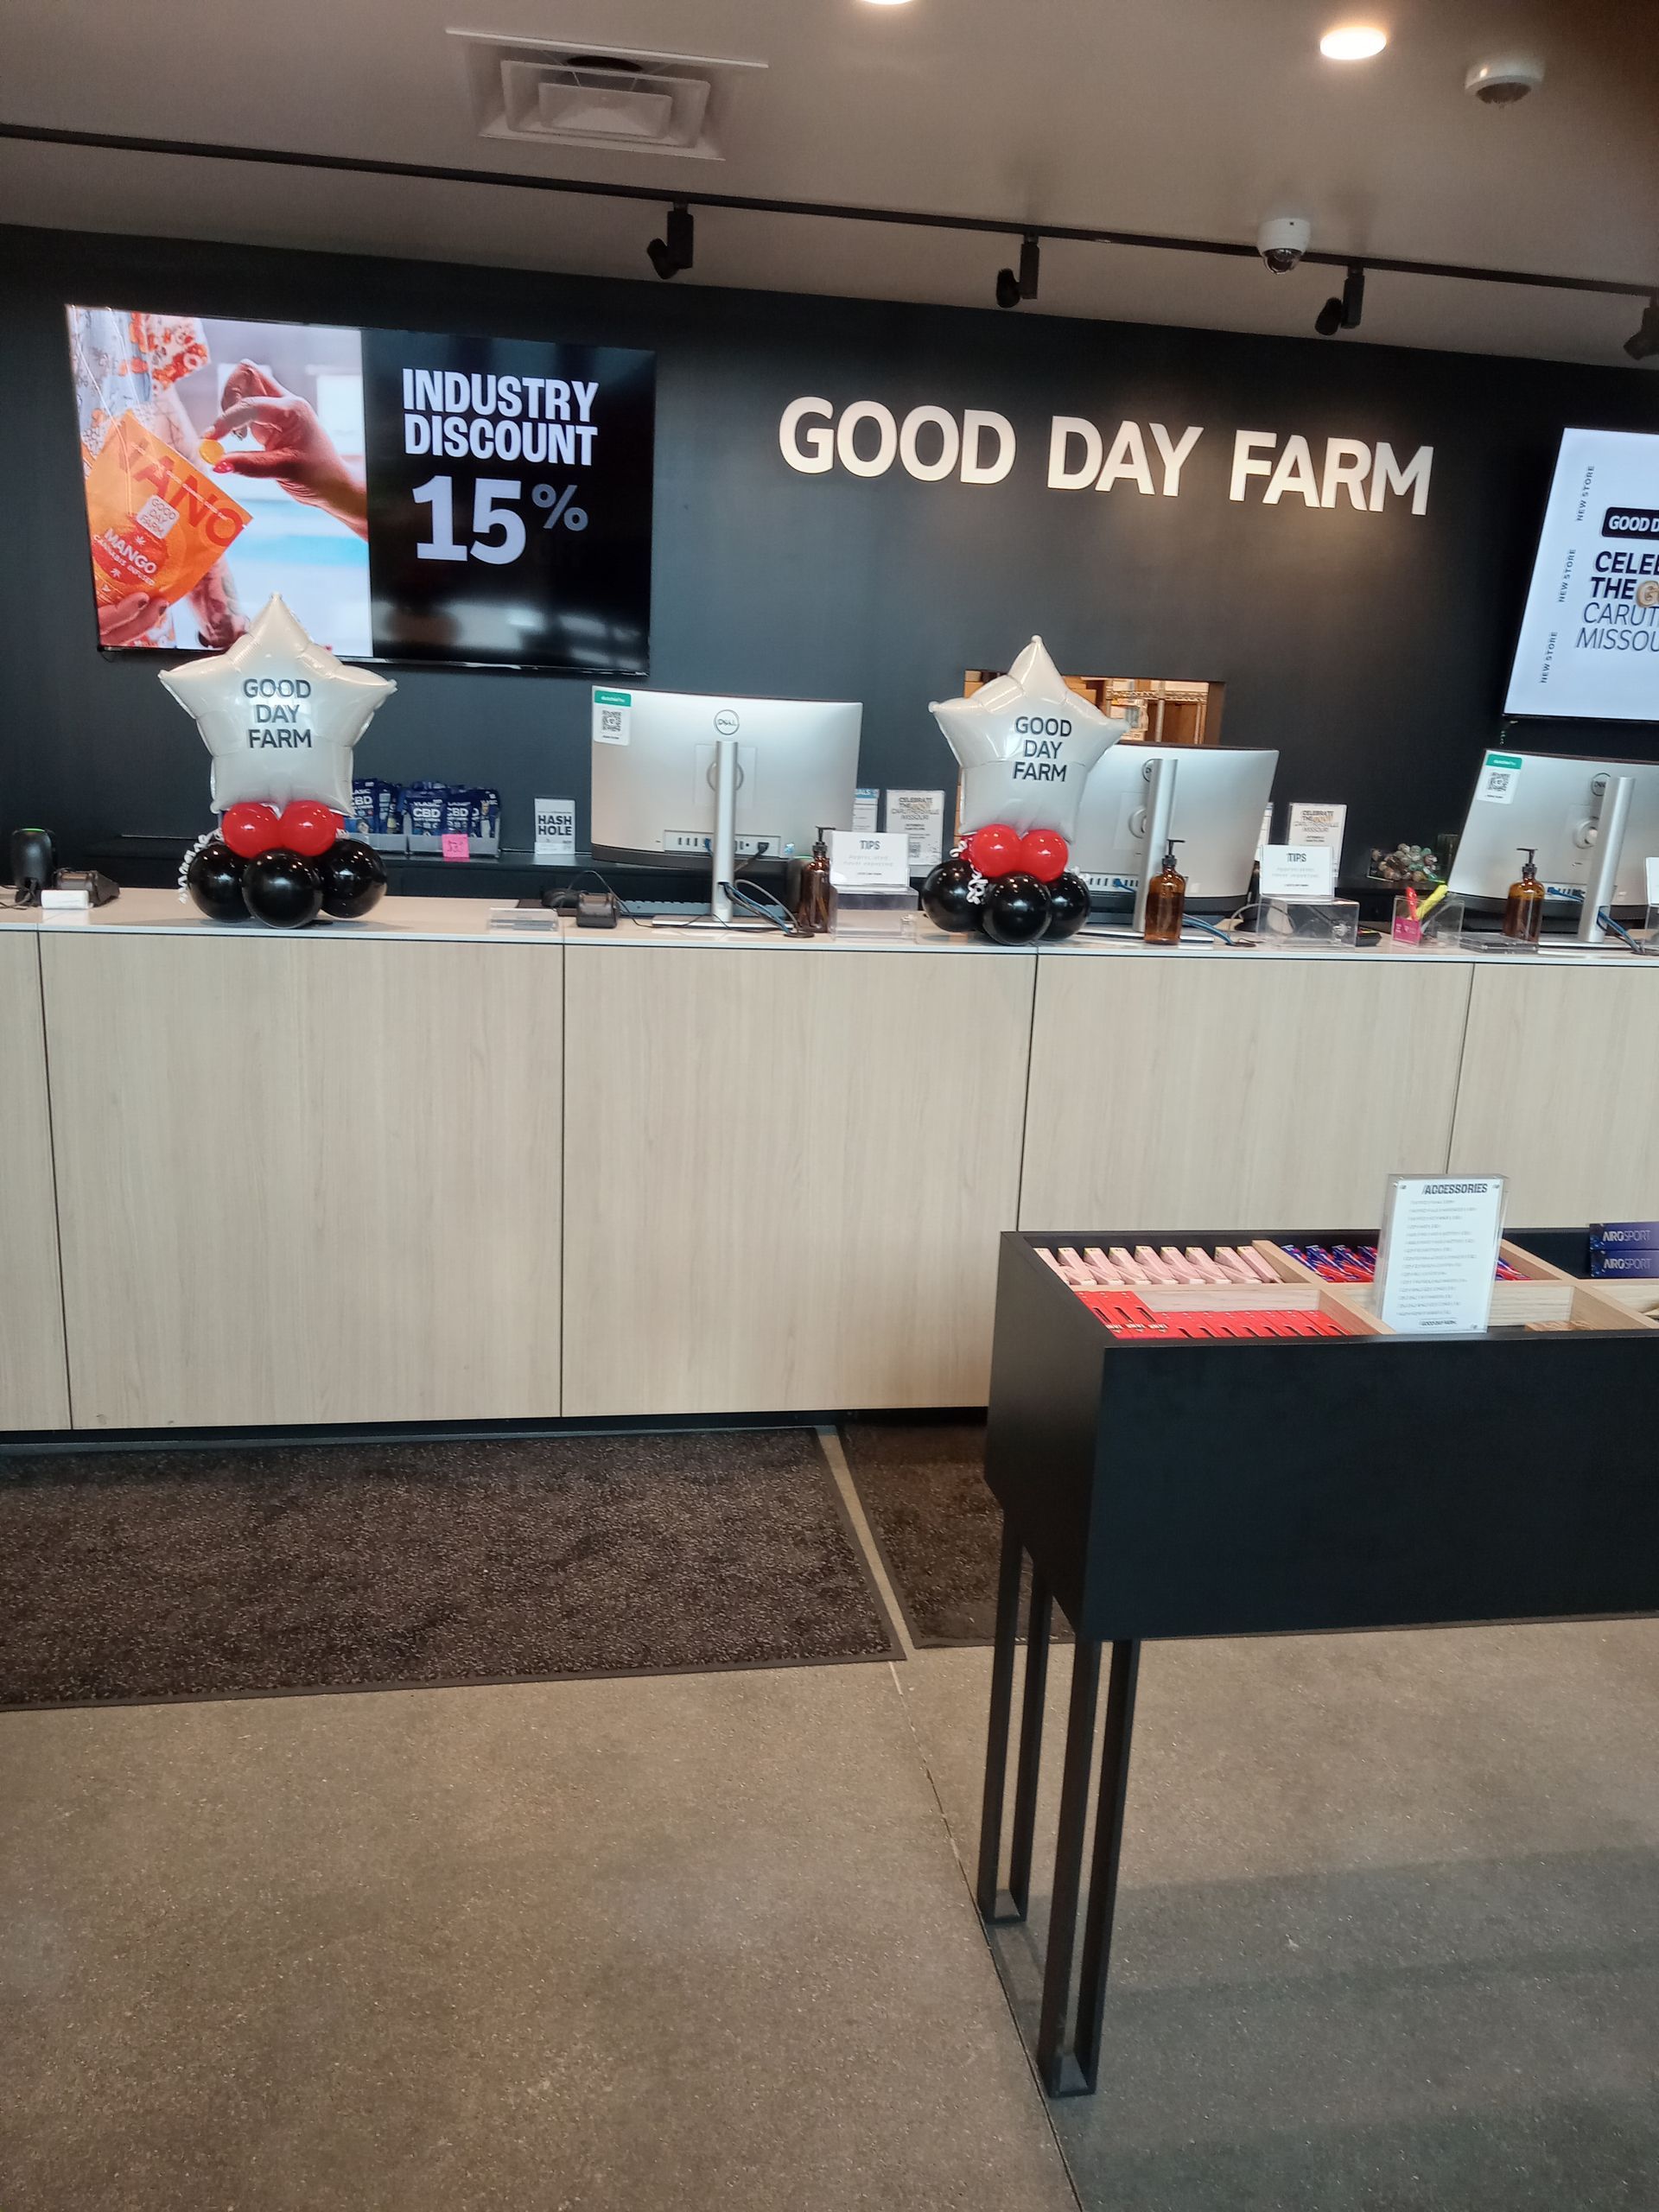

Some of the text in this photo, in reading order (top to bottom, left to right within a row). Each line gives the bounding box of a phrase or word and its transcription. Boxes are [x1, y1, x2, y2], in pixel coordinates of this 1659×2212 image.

[403, 368, 599, 423] INDUSTRY
[404, 413, 598, 466] DISCOUNT
[779, 396, 1434, 516] GOOD DAY FARM
[1576, 465, 1595, 521] NEW STORE
[1609, 515, 1650, 531] GOOD
[104, 528, 157, 575] MANGO
[1559, 549, 1576, 603] NEW STORE
[1591, 576, 1637, 600] THE
[1541, 632, 1558, 683] NEW STORE
[243, 678, 312, 699] GOOD
[255, 704, 300, 723] DAY
[1014, 716, 1072, 737] GOOD
[248, 728, 313, 748] FARM
[1024, 740, 1064, 760] DAY
[1013, 762, 1068, 782] FARM
[413, 807, 442, 818] CBD
[537, 815, 572, 825] HASH
[537, 825, 573, 836] HOLE
[859, 840, 881, 850] TIPS
[1287, 853, 1307, 862] TIPS
[1424, 1183, 1488, 1195] ACCESSORIES
